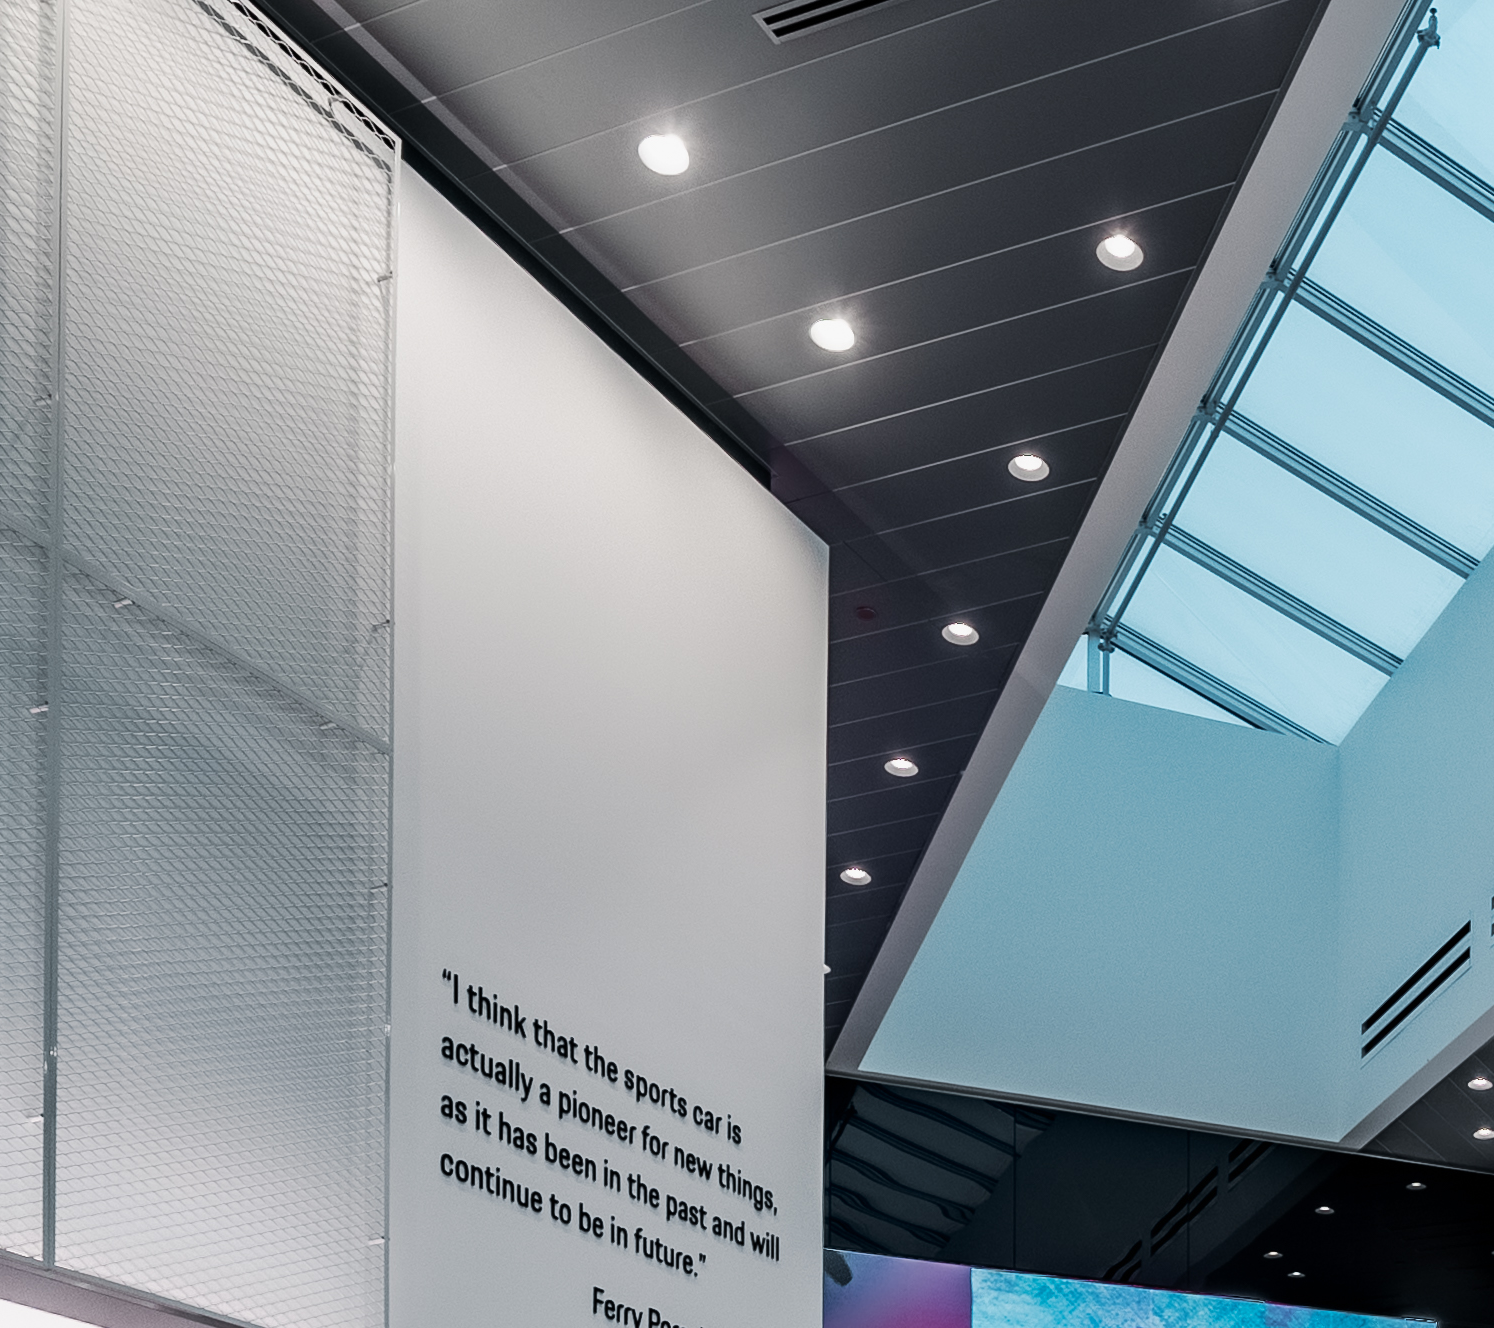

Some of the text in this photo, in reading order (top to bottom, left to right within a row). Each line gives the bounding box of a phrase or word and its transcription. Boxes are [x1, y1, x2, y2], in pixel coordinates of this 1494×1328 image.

[441, 1037, 777, 1216] actually a pioneer for new things,
[467, 985, 526, 1039] think
[533, 1019, 578, 1064] that
[584, 1045, 618, 1083] the
[624, 1070, 687, 1118] sports
[693, 1106, 722, 1134] car
[728, 1114, 741, 1145] is
[440, 1154, 542, 1213] continue
[549, 1194, 571, 1225] to
[579, 1203, 604, 1238] be
[611, 1216, 628, 1249] in
[441, 1095, 779, 1261] as it has been in the past and will
